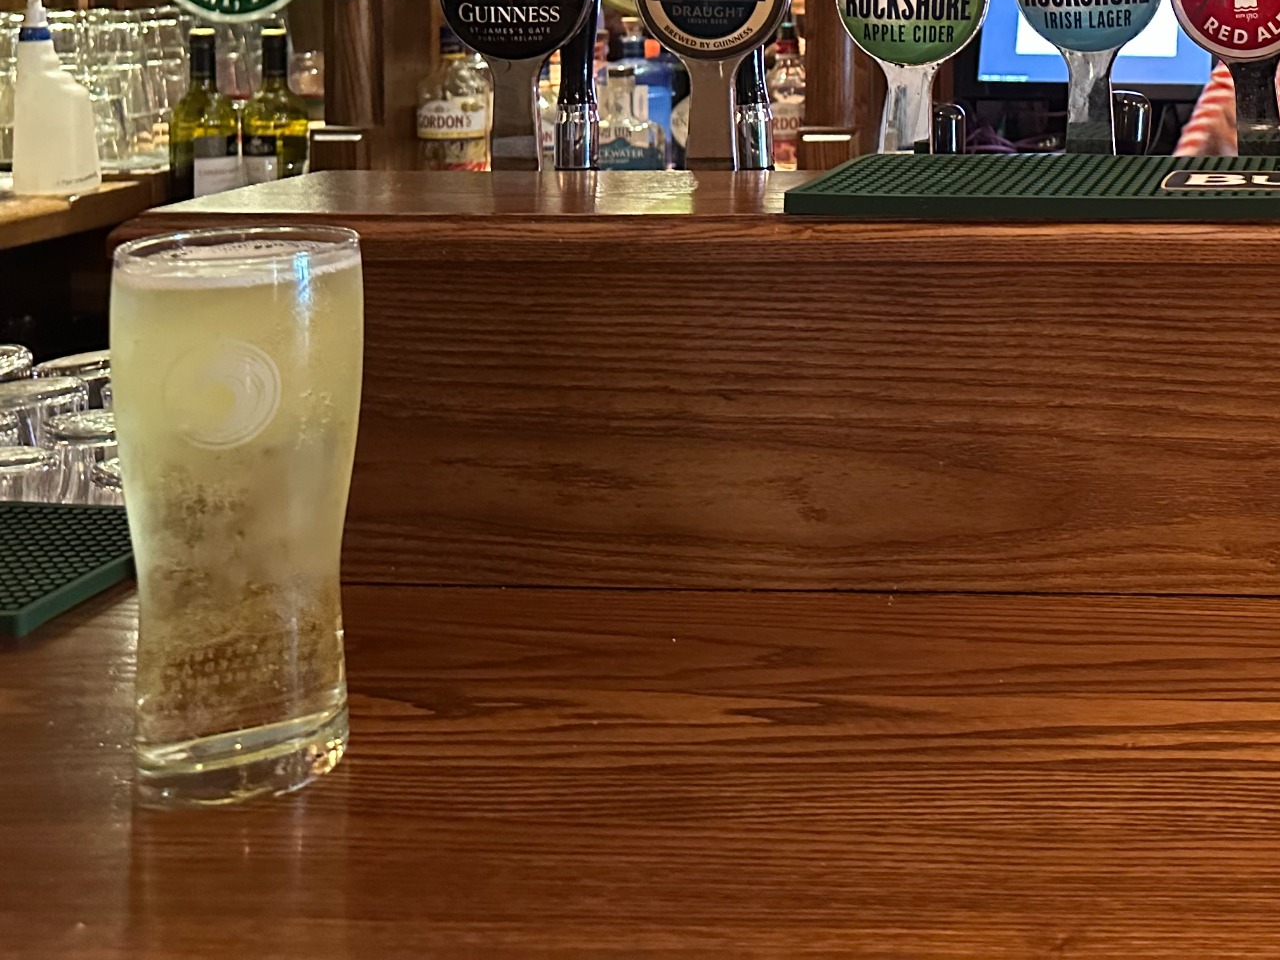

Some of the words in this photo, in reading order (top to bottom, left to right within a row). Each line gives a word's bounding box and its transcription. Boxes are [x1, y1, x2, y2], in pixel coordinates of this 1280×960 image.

[458, 2, 560, 23] GUINNESS
[672, 5, 744, 17] DRAUGHT
[1044, 10, 1082, 29] IRISH
[1088, 9, 1131, 28] LAGER
[528, 26, 551, 34] GATE
[664, 25, 697, 47] BREWED
[713, 27, 753, 49] GUINNESS
[863, 23, 905, 43] APPLE
[913, 24, 954, 43] CIDER
[1203, 16, 1248, 44] RED
